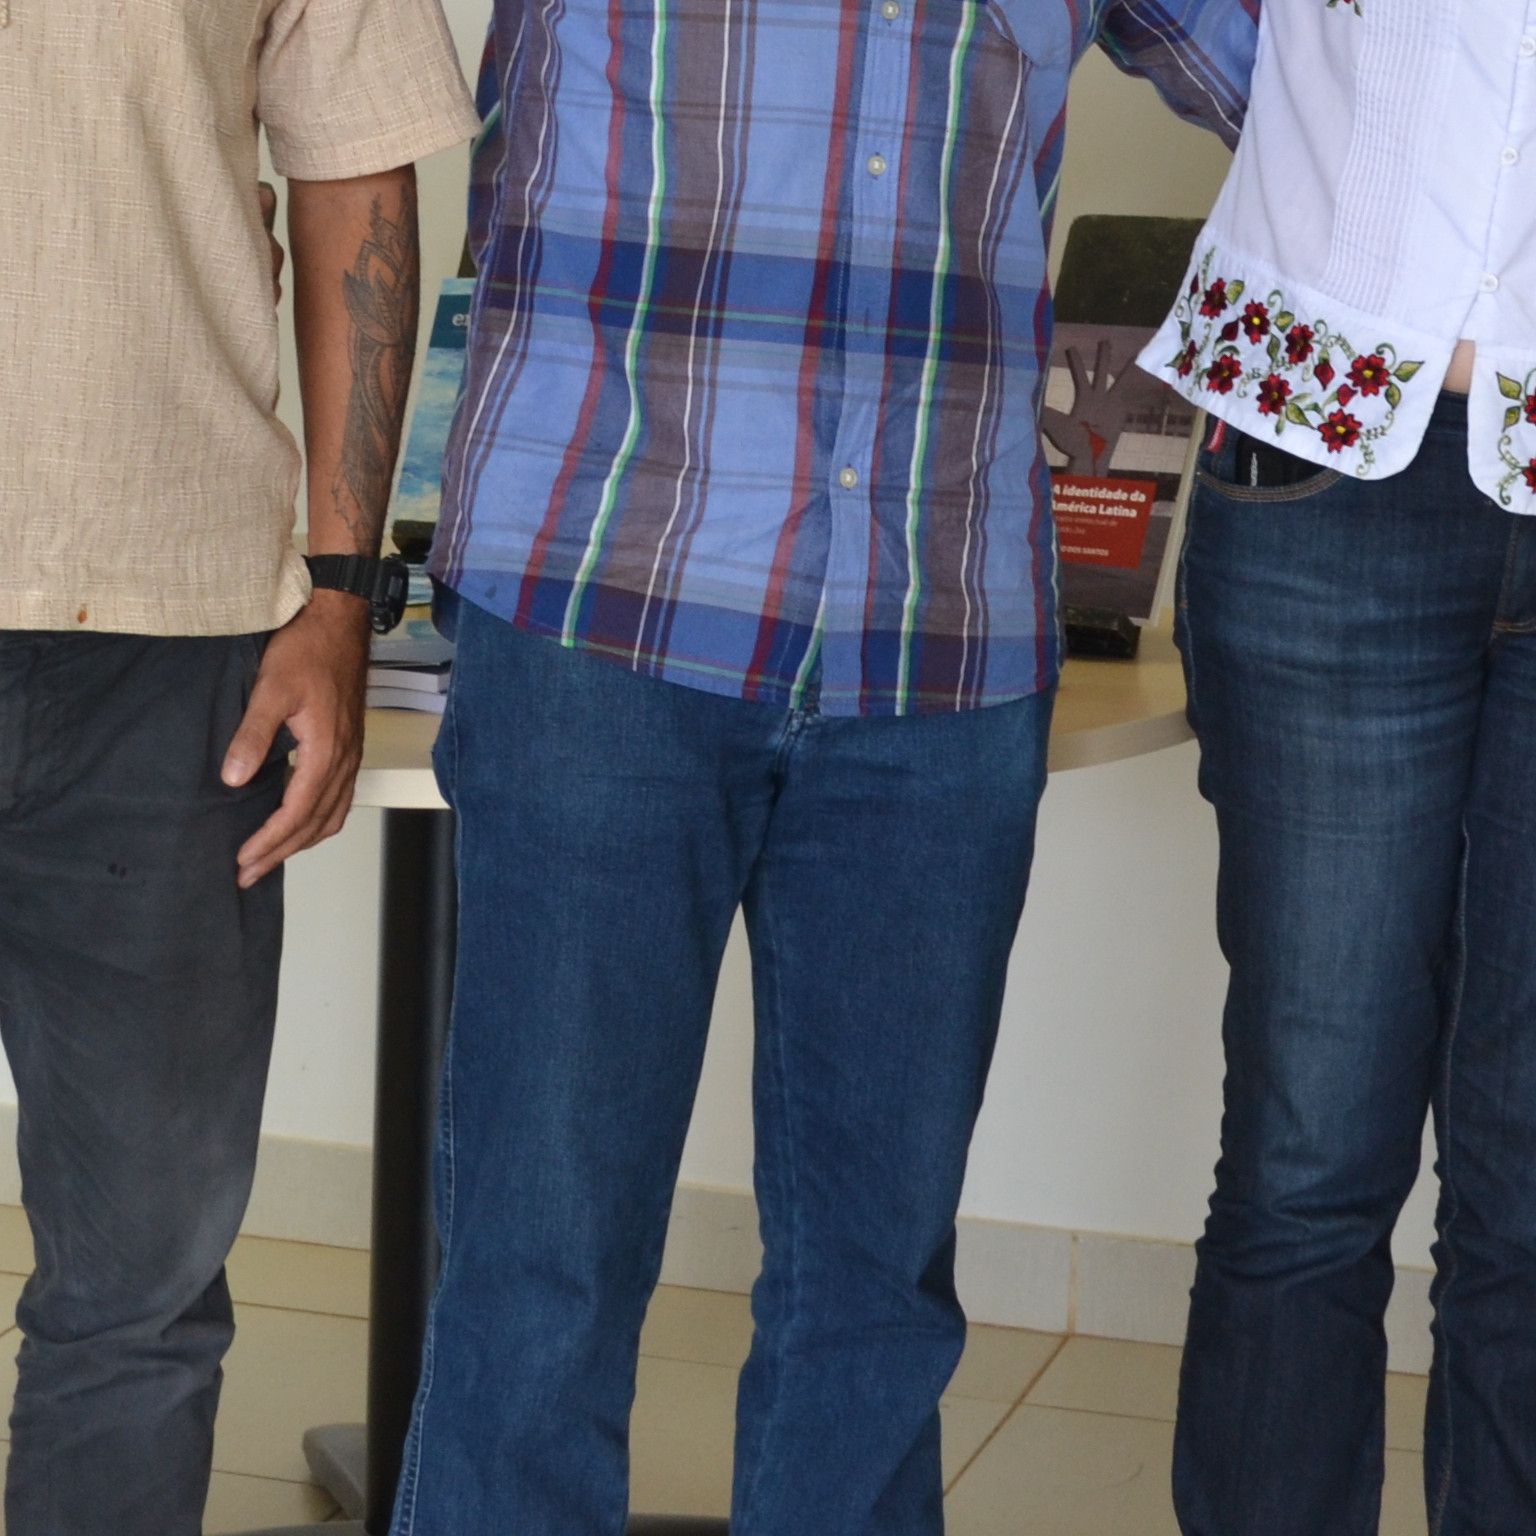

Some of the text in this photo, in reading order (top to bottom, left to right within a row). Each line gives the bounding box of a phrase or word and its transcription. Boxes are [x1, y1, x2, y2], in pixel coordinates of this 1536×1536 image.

[1062, 484, 1128, 501] identidade
[1129, 490, 1146, 502] da
[1098, 504, 1137, 518] Latina
